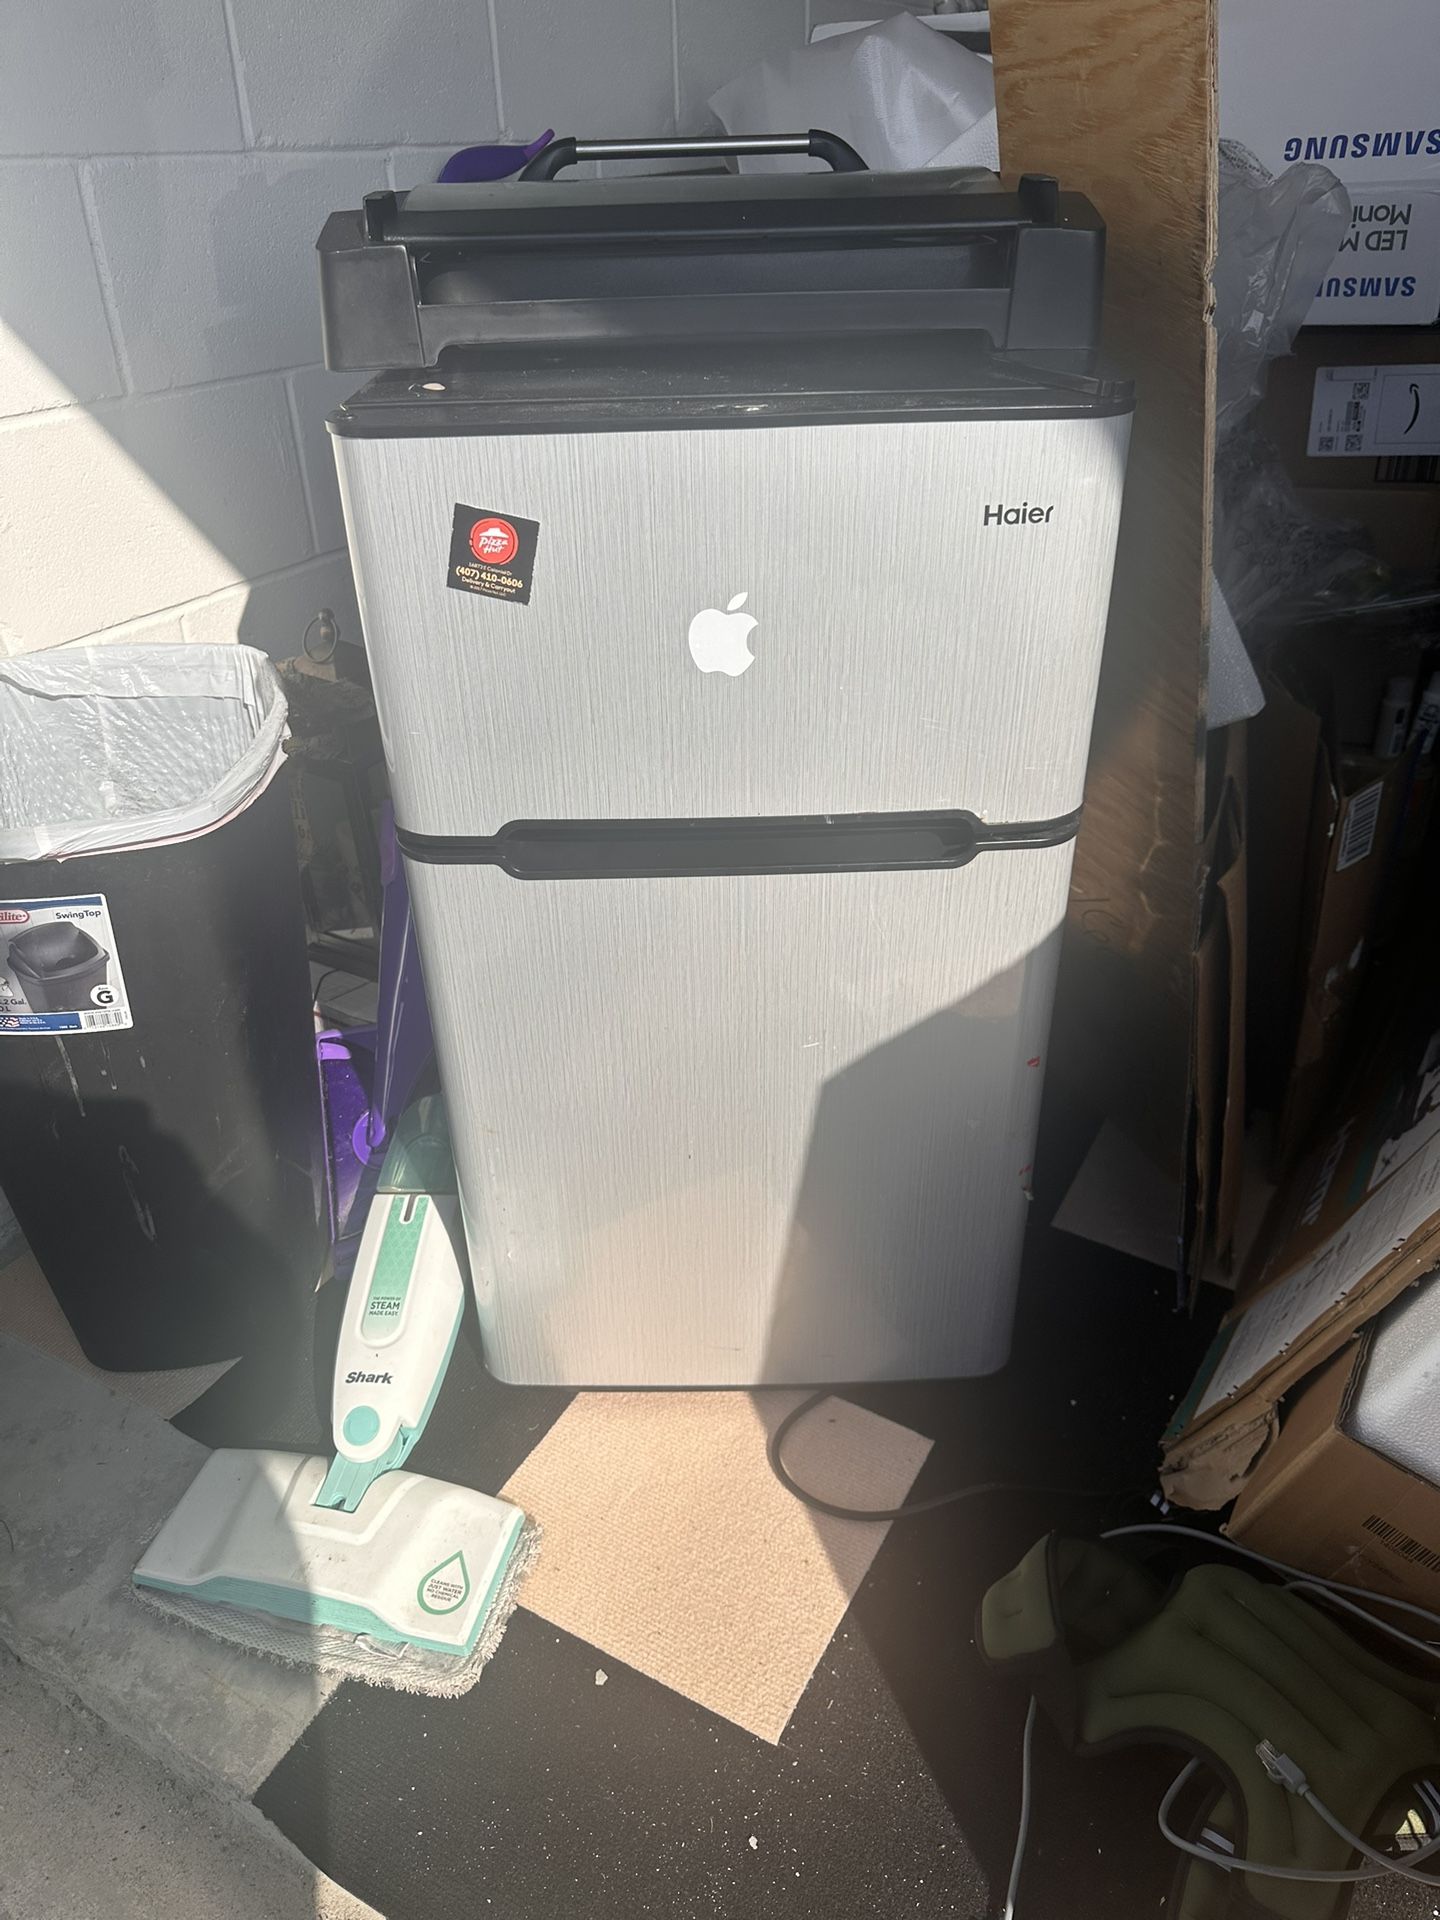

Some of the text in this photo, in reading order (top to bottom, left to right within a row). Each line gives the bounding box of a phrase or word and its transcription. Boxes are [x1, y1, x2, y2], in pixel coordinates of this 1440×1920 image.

[1284, 129, 1440, 162] SAMSUNG
[1351, 203, 1412, 228] Moni
[1365, 229, 1408, 251] LED
[984, 502, 1054, 526] Haier
[483, 545, 504, 554] Hut
[456, 566, 523, 588] (407) 410-0606
[461, 576, 484, 587] Delivery
[491, 583, 516, 595] Carryout
[97, 990, 113, 1004] G
[370, 1301, 400, 1310] STEAM
[345, 1371, 394, 1385] Shark
[443, 1586, 462, 1595] WATER
